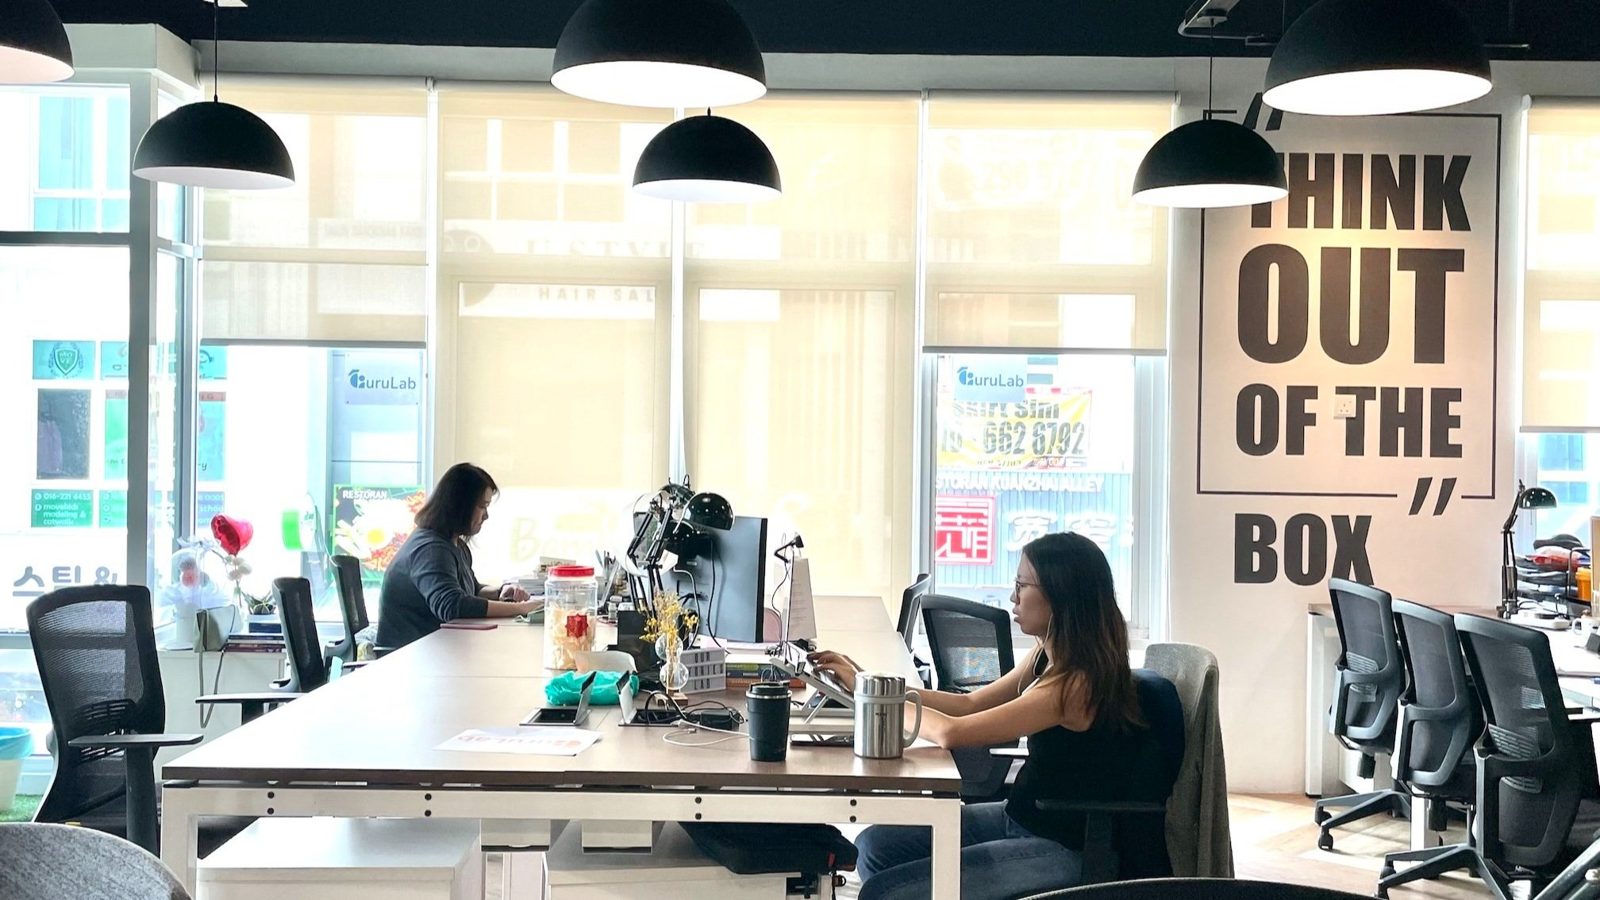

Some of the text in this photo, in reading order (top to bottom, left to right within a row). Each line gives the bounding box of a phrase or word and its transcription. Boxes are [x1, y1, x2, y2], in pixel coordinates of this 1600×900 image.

[1251, 152, 1472, 231] HINK
[538, 287, 597, 301] HAIR
[1237, 243, 1465, 365] OUT
[1032, 421, 1086, 456] 6792
[1235, 382, 1463, 458] OF THE
[342, 489, 388, 500] RESTORAN
[1234, 512, 1375, 586] BOX
